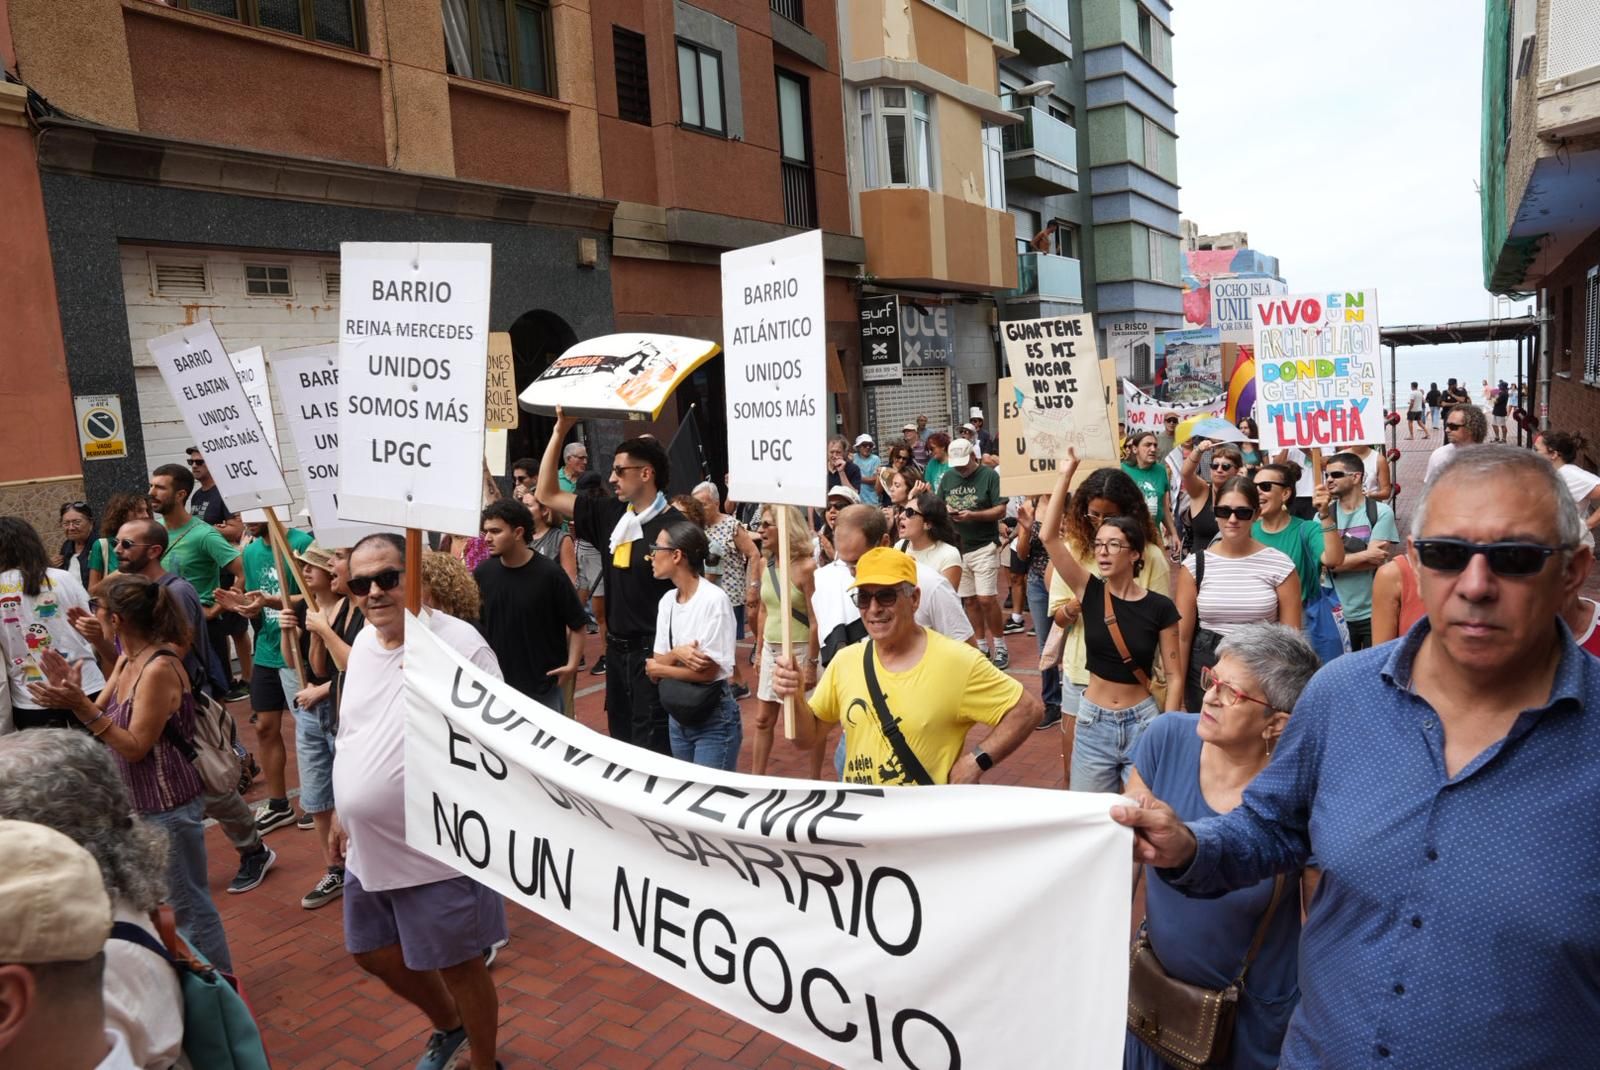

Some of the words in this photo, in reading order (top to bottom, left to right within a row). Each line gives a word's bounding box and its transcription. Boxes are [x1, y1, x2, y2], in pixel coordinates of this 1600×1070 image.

[372, 280, 452, 303] BARRIO
[743, 277, 798, 305] BARRIO
[1215, 283, 1248, 297] OCHO
[1327, 292, 1364, 308] EN
[861, 302, 894, 320] surf
[1325, 309, 1365, 323] UN
[346, 319, 392, 336] REINA
[397, 322, 473, 340] MERCEDES
[733, 316, 812, 346] ATLÁNTICO
[862, 322, 895, 336] shop
[1114, 323, 1123, 331] EL
[1124, 322, 1148, 331] RISCO
[173, 349, 213, 372] BARRIO
[924, 343, 946, 361] shop
[1026, 342, 1044, 359] ES
[1051, 342, 1076, 358] MI
[368, 355, 451, 380] UNIDOS
[745, 359, 802, 382] UNIDOS
[1025, 361, 1072, 377] HOGAR
[1262, 357, 1350, 382] DONDE
[183, 386, 197, 401] EL
[197, 376, 230, 397] BATAN
[1033, 379, 1049, 394] NO
[1056, 379, 1078, 393] MI
[1263, 378, 1349, 402] GENTE
[301, 403, 322, 420] LA
[348, 395, 419, 419] SOMOS
[425, 398, 468, 423] MÁS
[734, 400, 782, 419] SOMOS
[786, 394, 816, 417] MÁS
[1035, 396, 1074, 409] LUJO
[198, 404, 239, 426] UNIDOS
[1274, 407, 1365, 447] LUCHA
[202, 434, 238, 453] SOMOS
[238, 427, 260, 445] MÁS
[751, 439, 792, 461] LPGC
[372, 438, 431, 468] LPGC
[225, 459, 258, 480] LPGC
[636, 815, 922, 957] BARRIO
[434, 792, 491, 870] NO
[509, 829, 574, 910] UN
[612, 866, 961, 1070] NEGOCIO
